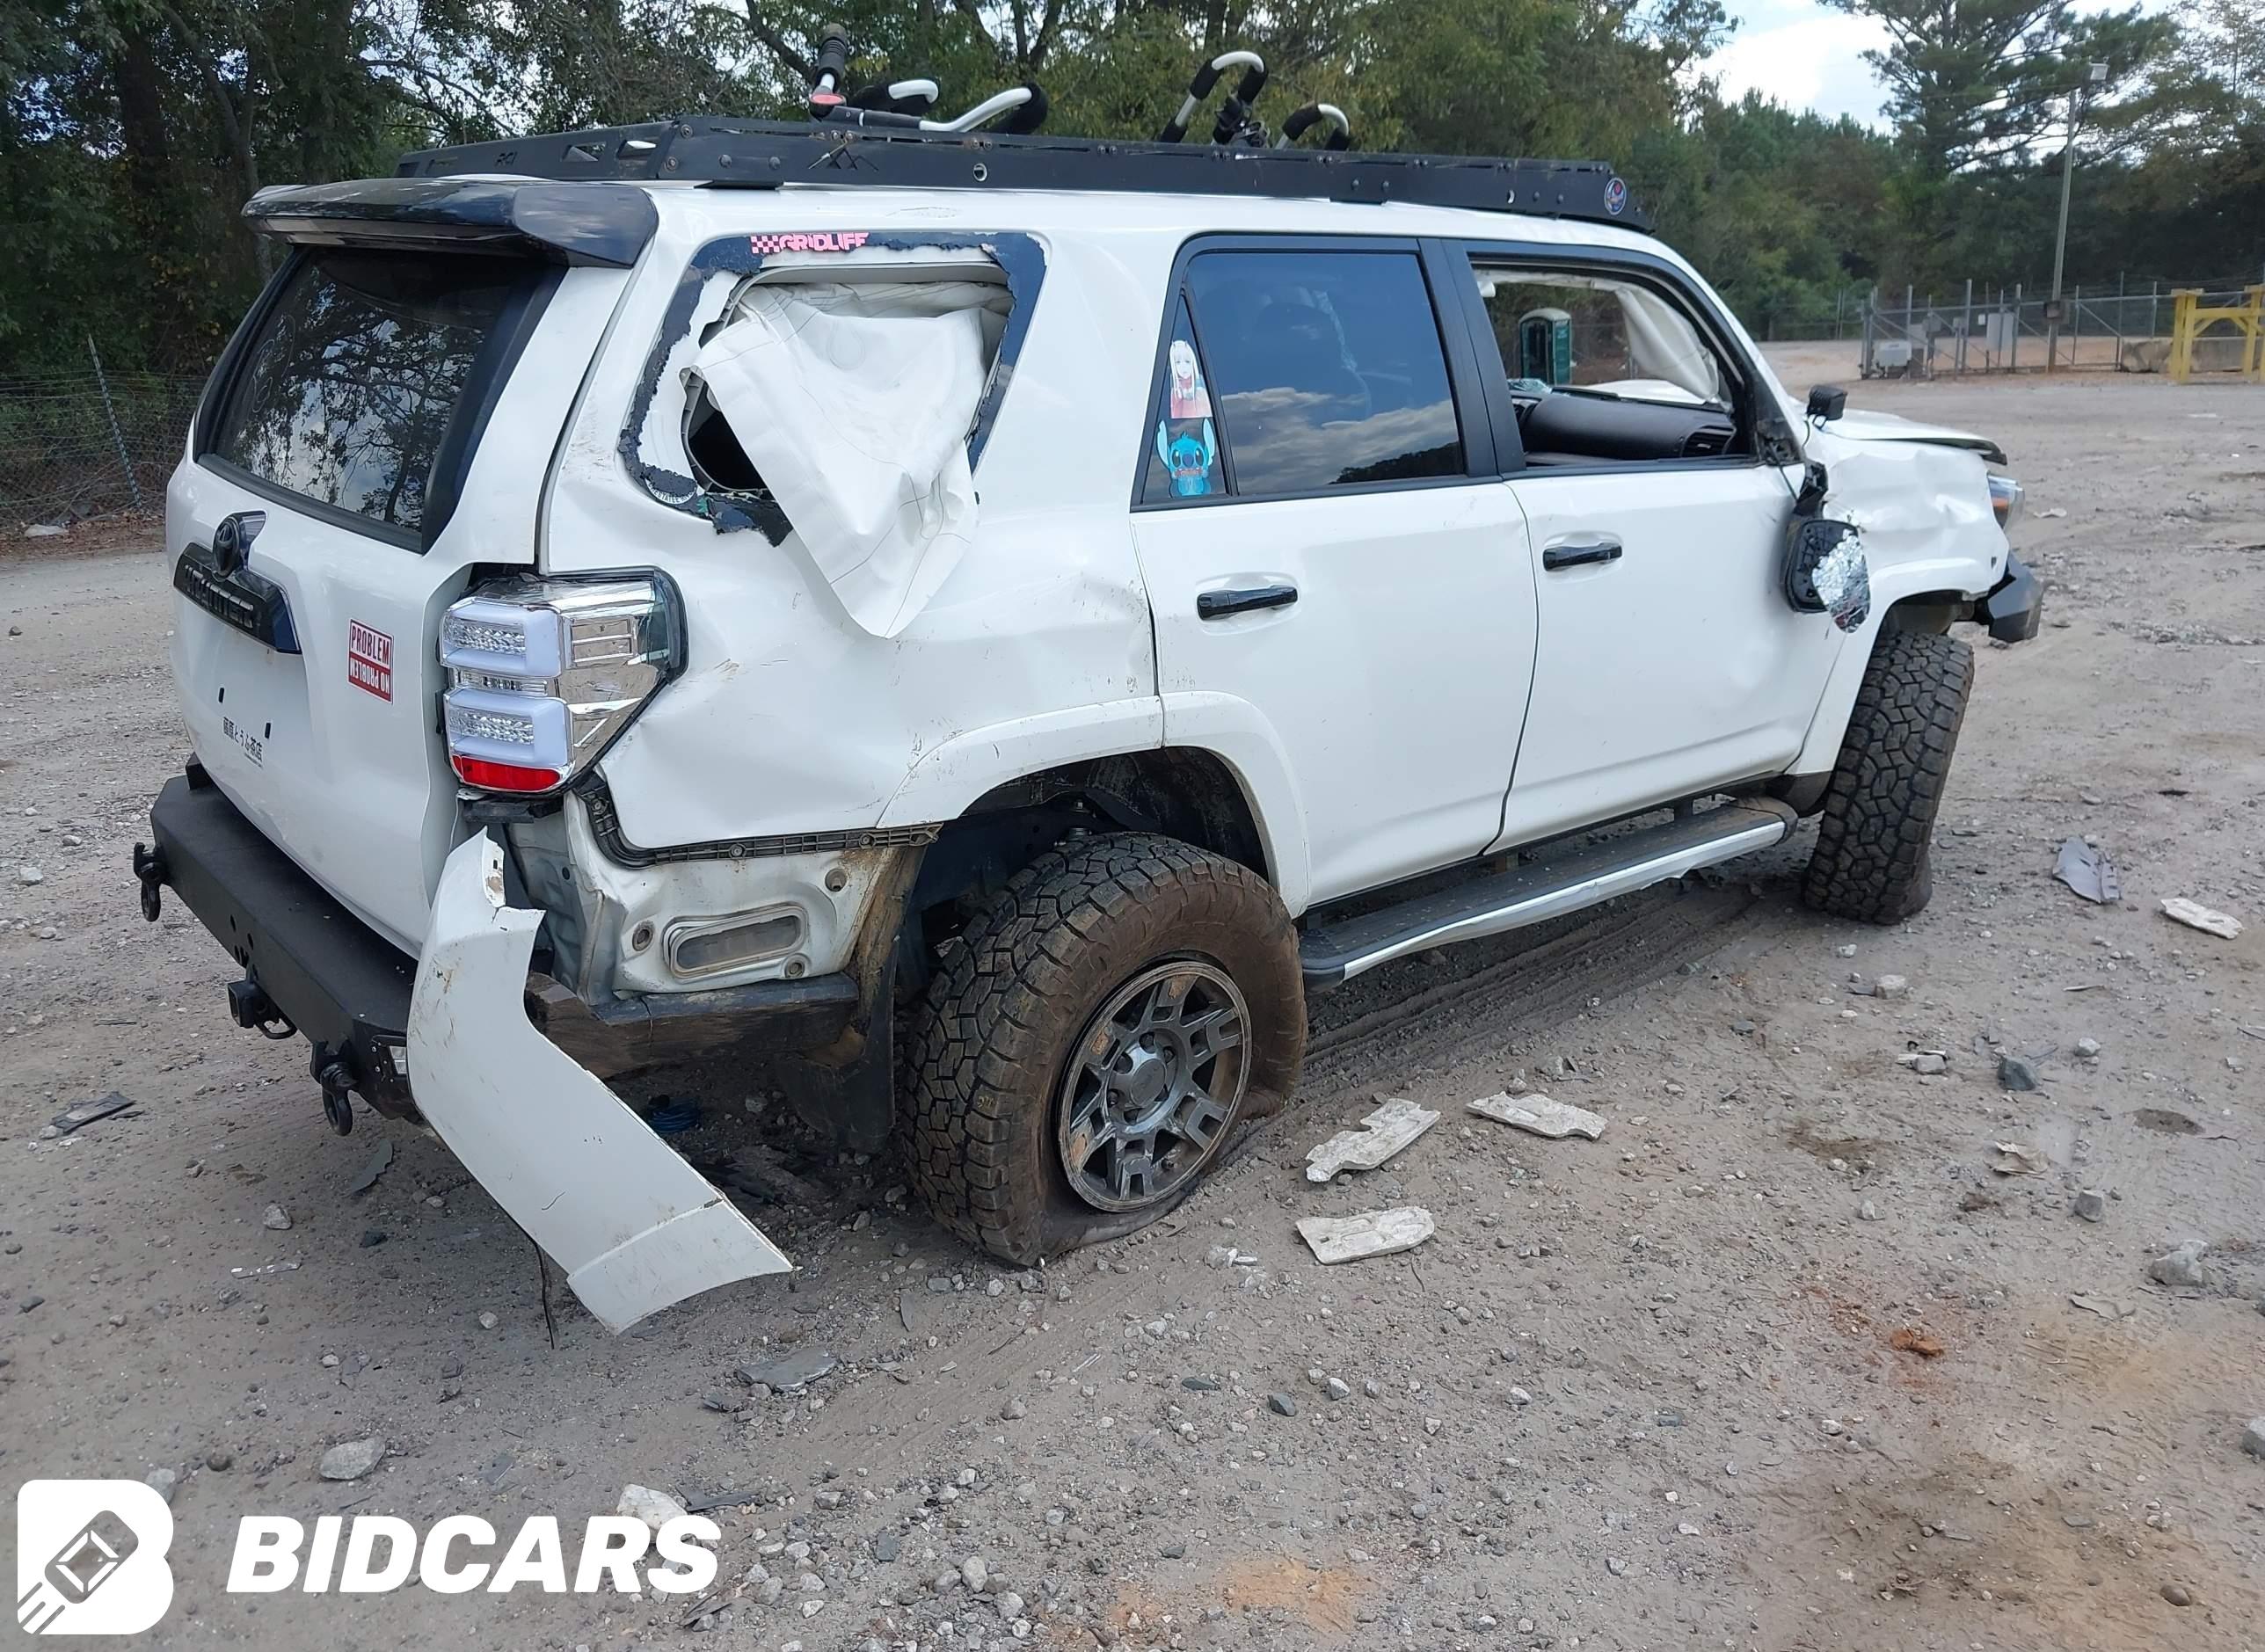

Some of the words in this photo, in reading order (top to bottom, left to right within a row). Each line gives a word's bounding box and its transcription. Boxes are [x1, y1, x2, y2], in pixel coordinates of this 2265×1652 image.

[351, 625, 390, 666] PROBLEM
[349, 659, 380, 690] PROBLEM
[380, 671, 390, 695] NO
